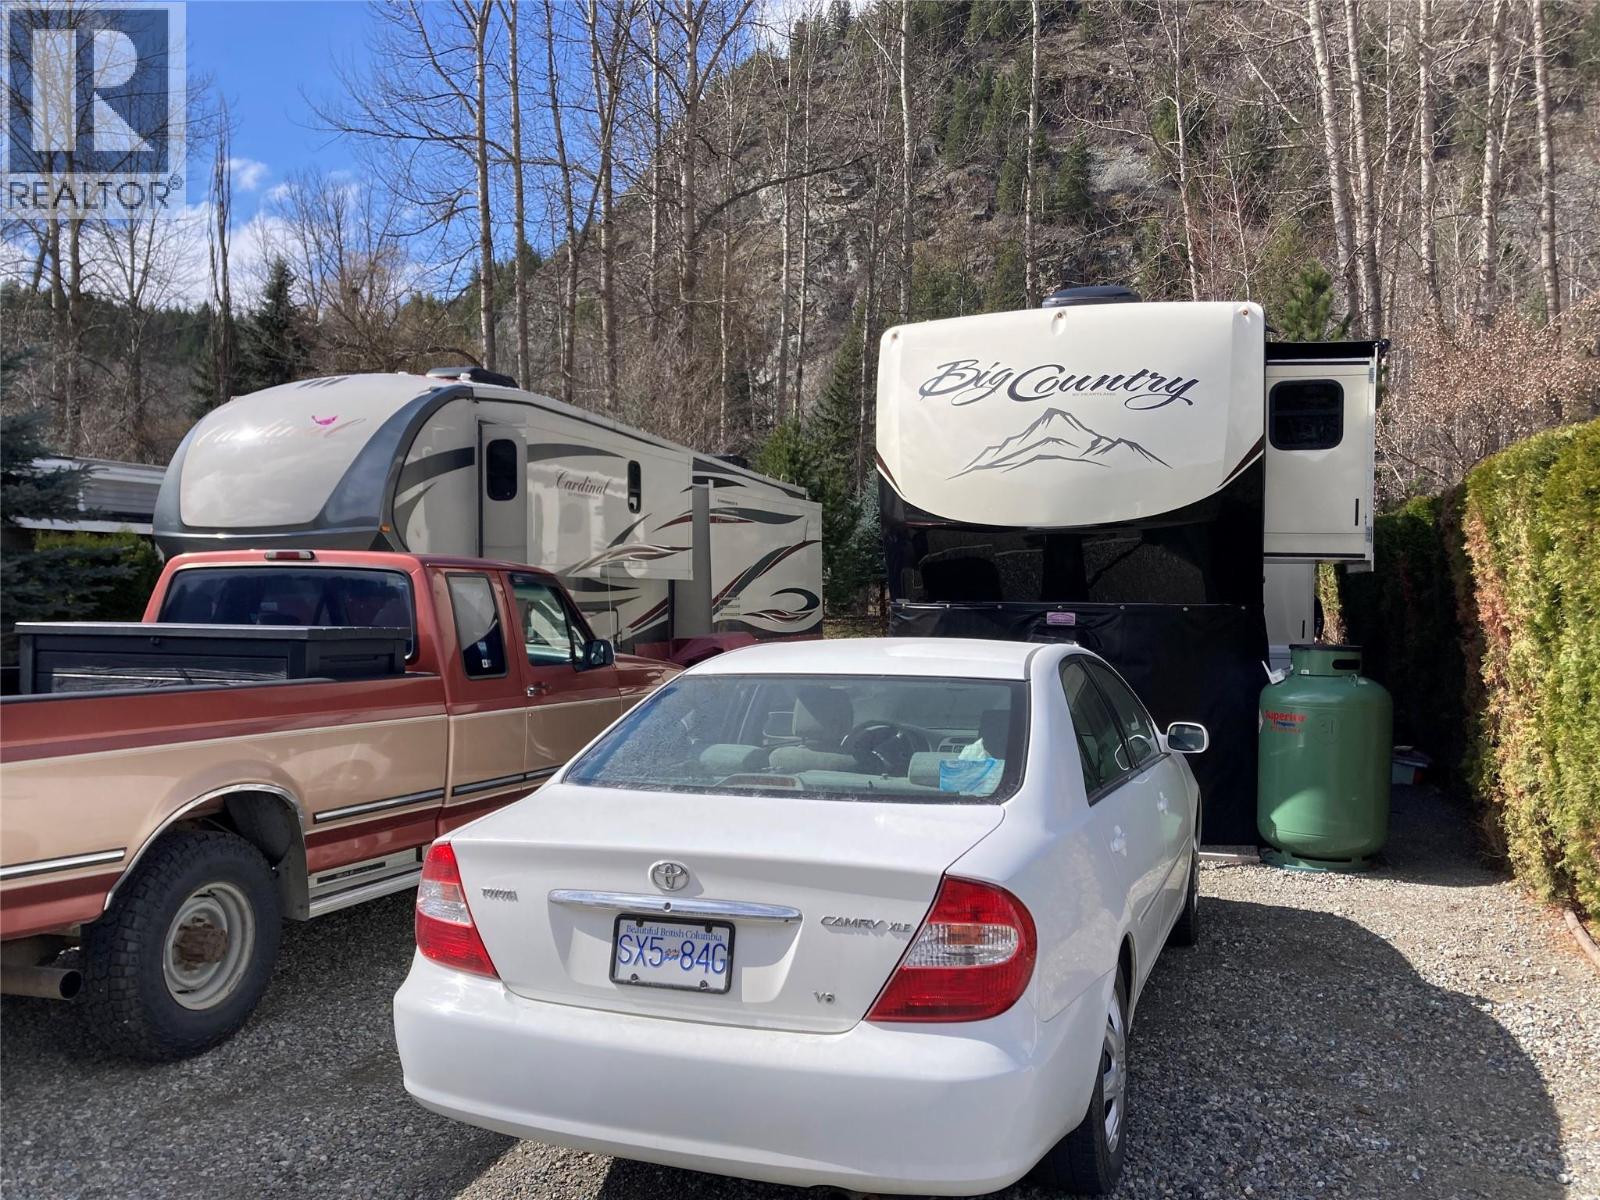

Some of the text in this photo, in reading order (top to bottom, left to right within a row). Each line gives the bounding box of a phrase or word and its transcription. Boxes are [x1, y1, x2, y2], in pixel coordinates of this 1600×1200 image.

[918, 359, 1200, 411] Big Country
[556, 470, 612, 495] Cardinal
[626, 924, 723, 942] Beautiful British Columbia
[820, 915, 912, 933] CAMRY XLE
[618, 933, 728, 974] SX5 84G
